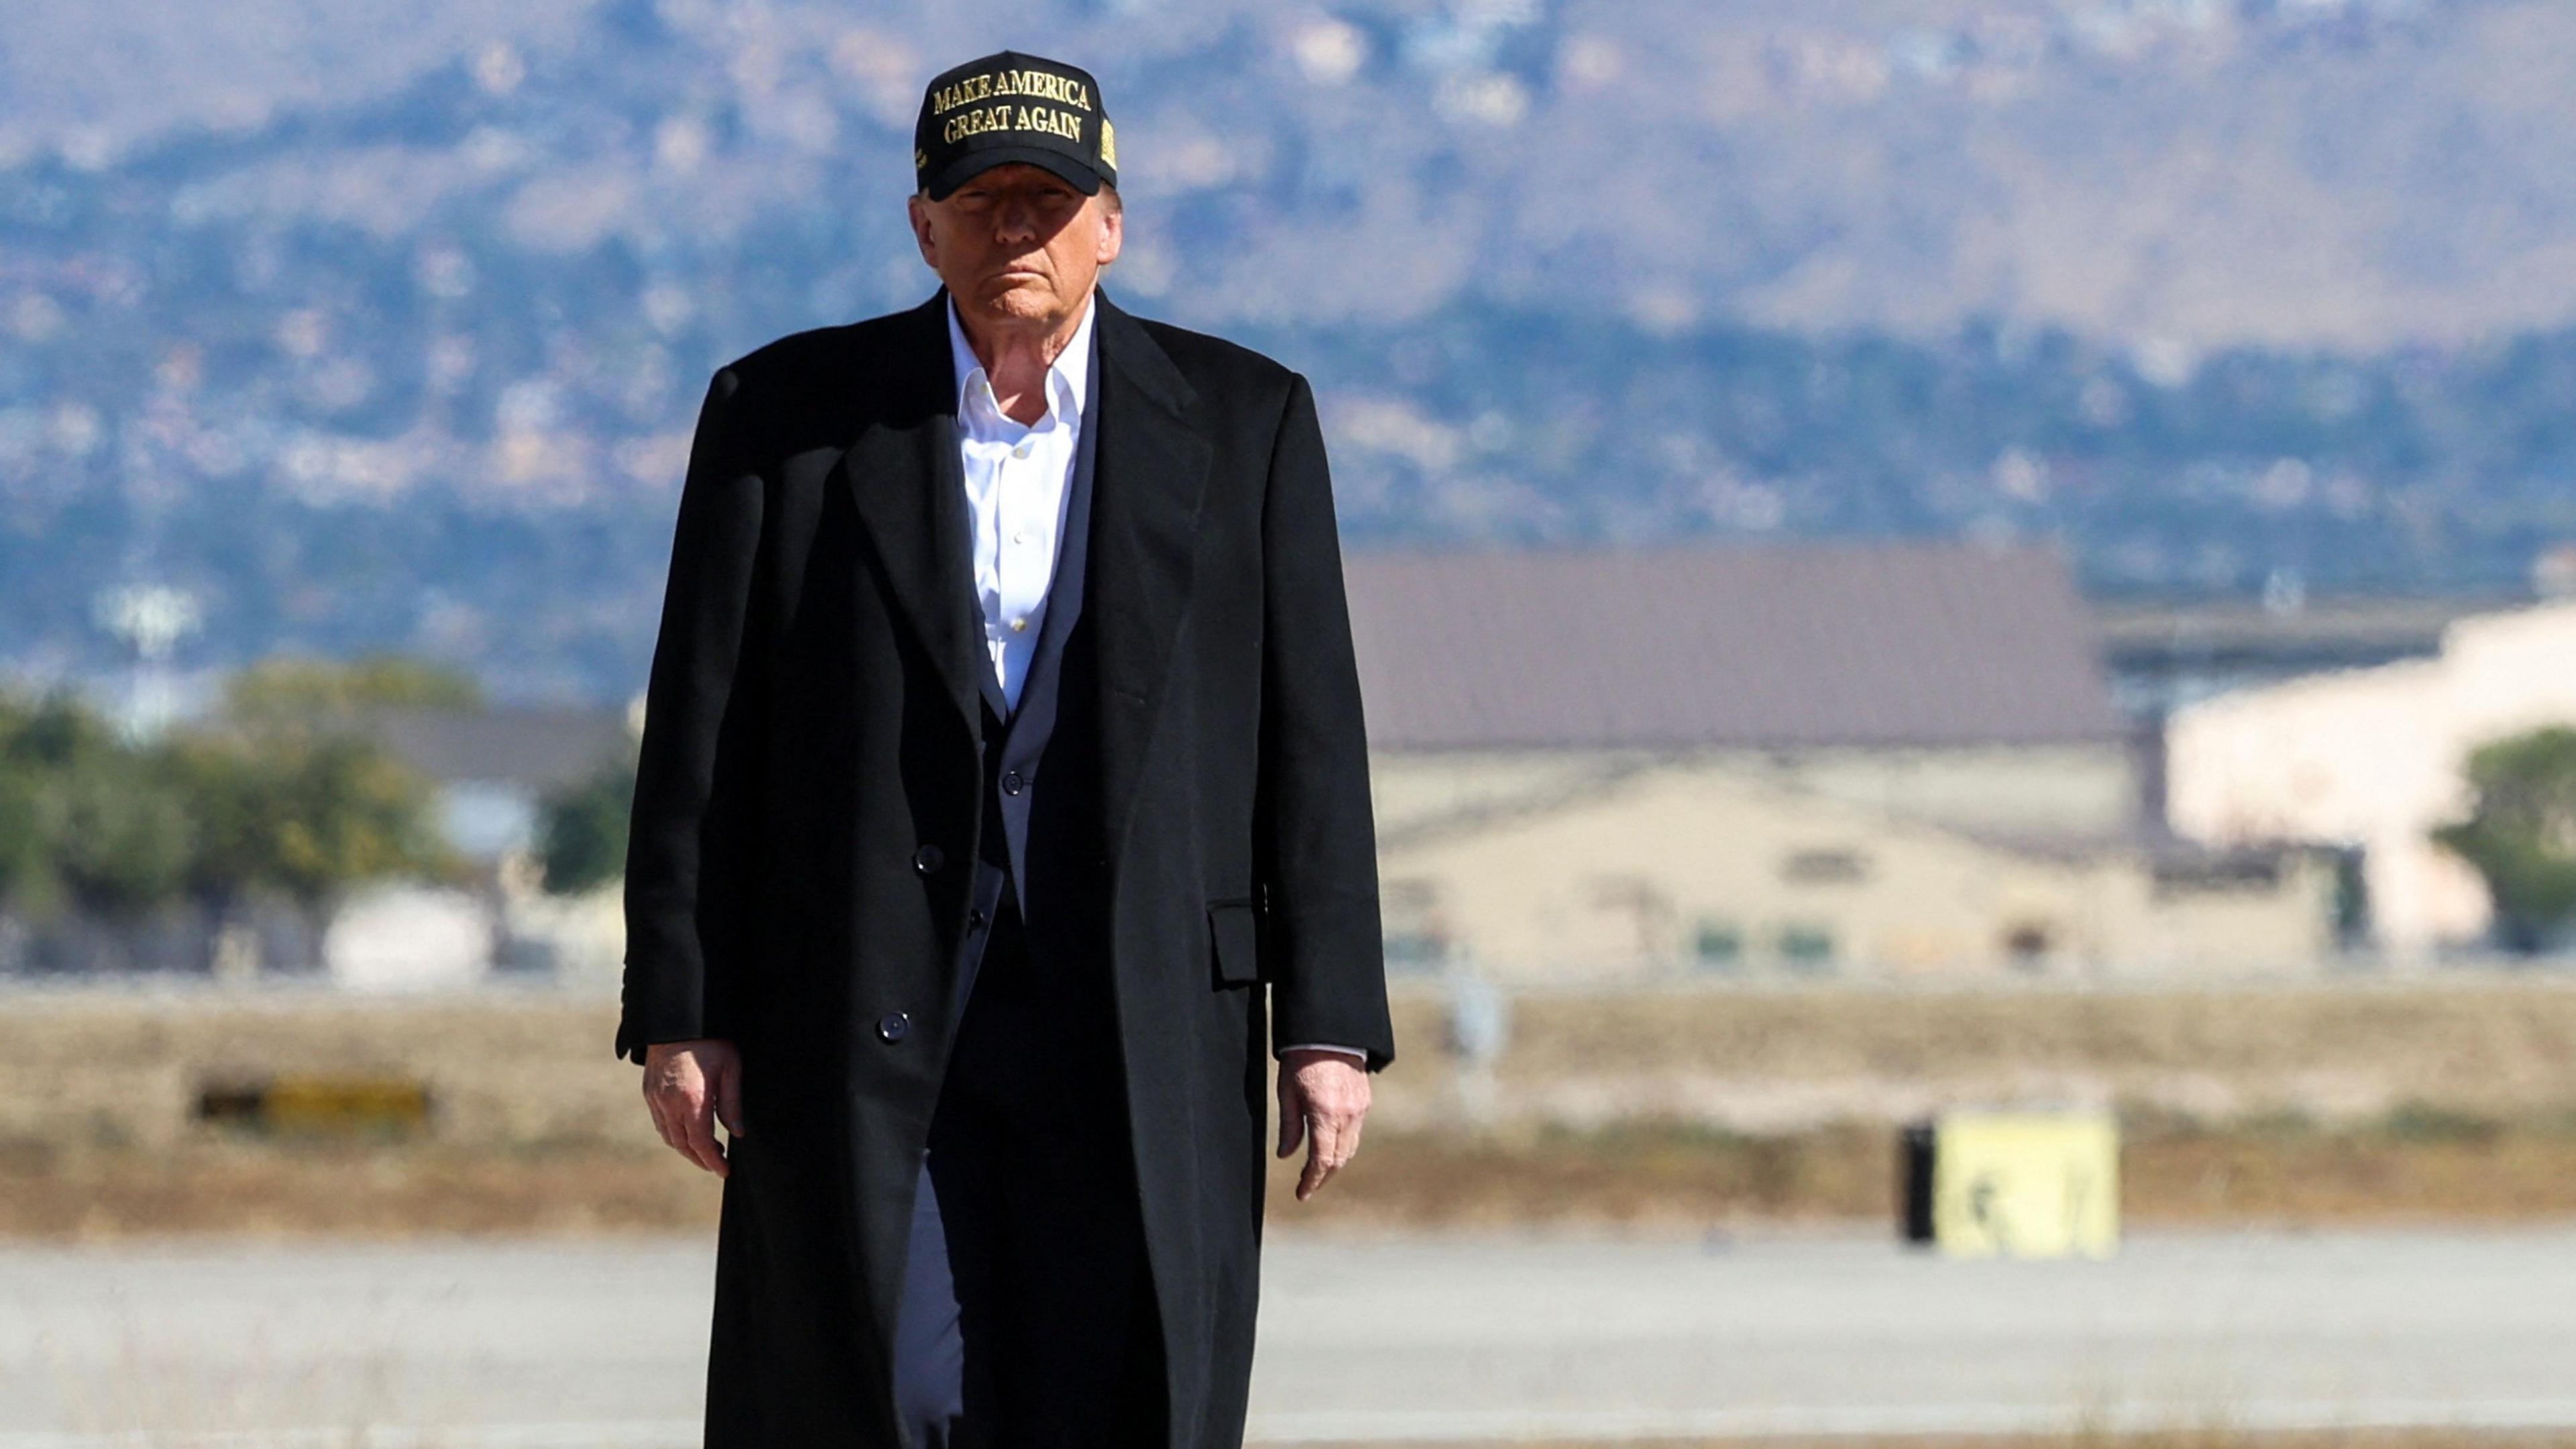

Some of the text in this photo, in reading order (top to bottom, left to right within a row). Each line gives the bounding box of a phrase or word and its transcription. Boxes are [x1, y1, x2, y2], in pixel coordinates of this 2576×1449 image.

[934, 70, 1091, 115] MAKE AMERICA
[944, 105, 1082, 144] GREAT AGAIN
